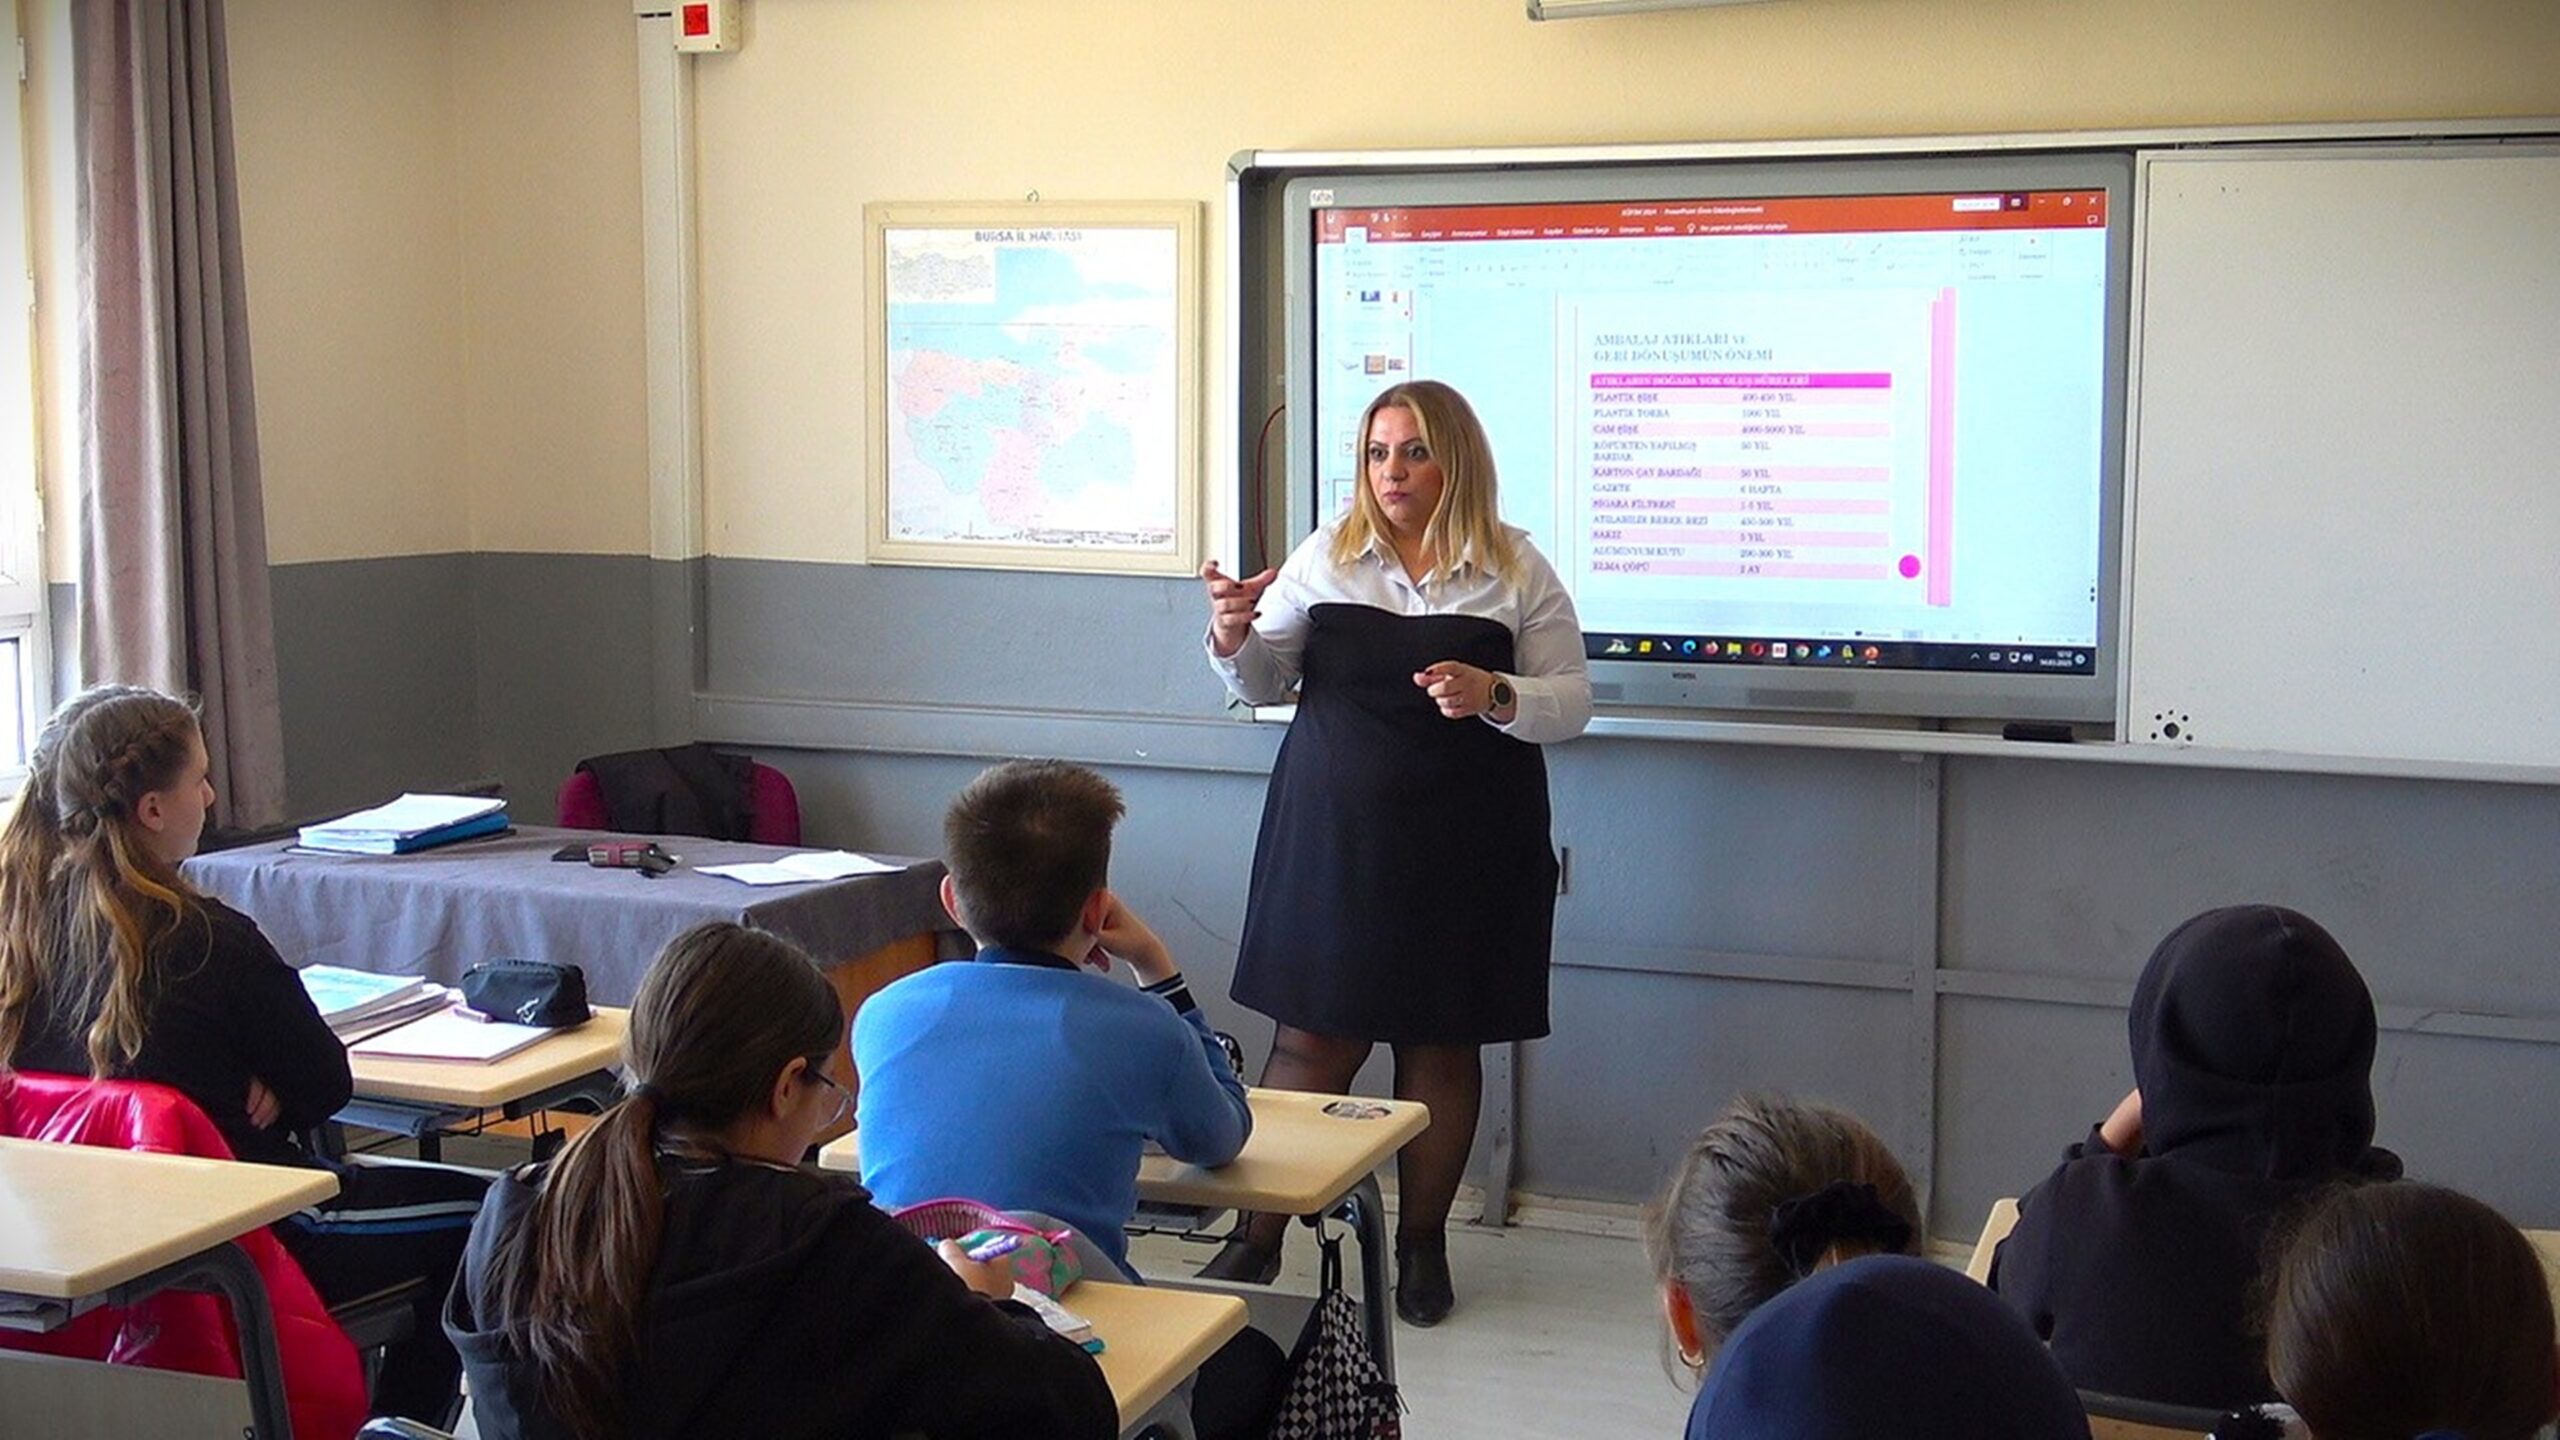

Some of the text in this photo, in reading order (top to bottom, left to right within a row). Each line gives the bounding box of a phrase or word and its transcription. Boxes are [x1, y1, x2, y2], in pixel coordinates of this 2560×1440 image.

[975, 230, 1014, 242] BURSA
[1029, 229, 1082, 242] HARTASI
[1594, 334, 1659, 345] AMBALAJ
[1662, 333, 1728, 344] ATIKLARI
[1594, 347, 1773, 363] GERİ DÖNÜŞÜMÜN ÖNEMİ
[1779, 393, 1796, 402] YIL
[1637, 408, 1670, 418] TORBA
[1765, 408, 1781, 418] YIL
[1593, 424, 1615, 434] CAM
[1788, 425, 1806, 434] YIL
[1593, 440, 1648, 450] KÖPÜKTEN
[1754, 441, 1771, 450] YIL
[1593, 468, 1633, 477] KARTON
[1754, 469, 1771, 478] YIL
[1593, 484, 1631, 492] GAZETE
[1749, 485, 1782, 494] HAFTA
[1756, 501, 1774, 511] YIL
[1650, 516, 1683, 525] BEBEK
[1777, 517, 1795, 527] YIL
[1593, 531, 1622, 540] SAKIZ
[1748, 533, 1765, 542] YIL
[1656, 547, 1686, 557] KUTU
[1777, 549, 1795, 559] YIL
[1593, 562, 1621, 571] ELMA
[1748, 564, 1761, 574] AY
